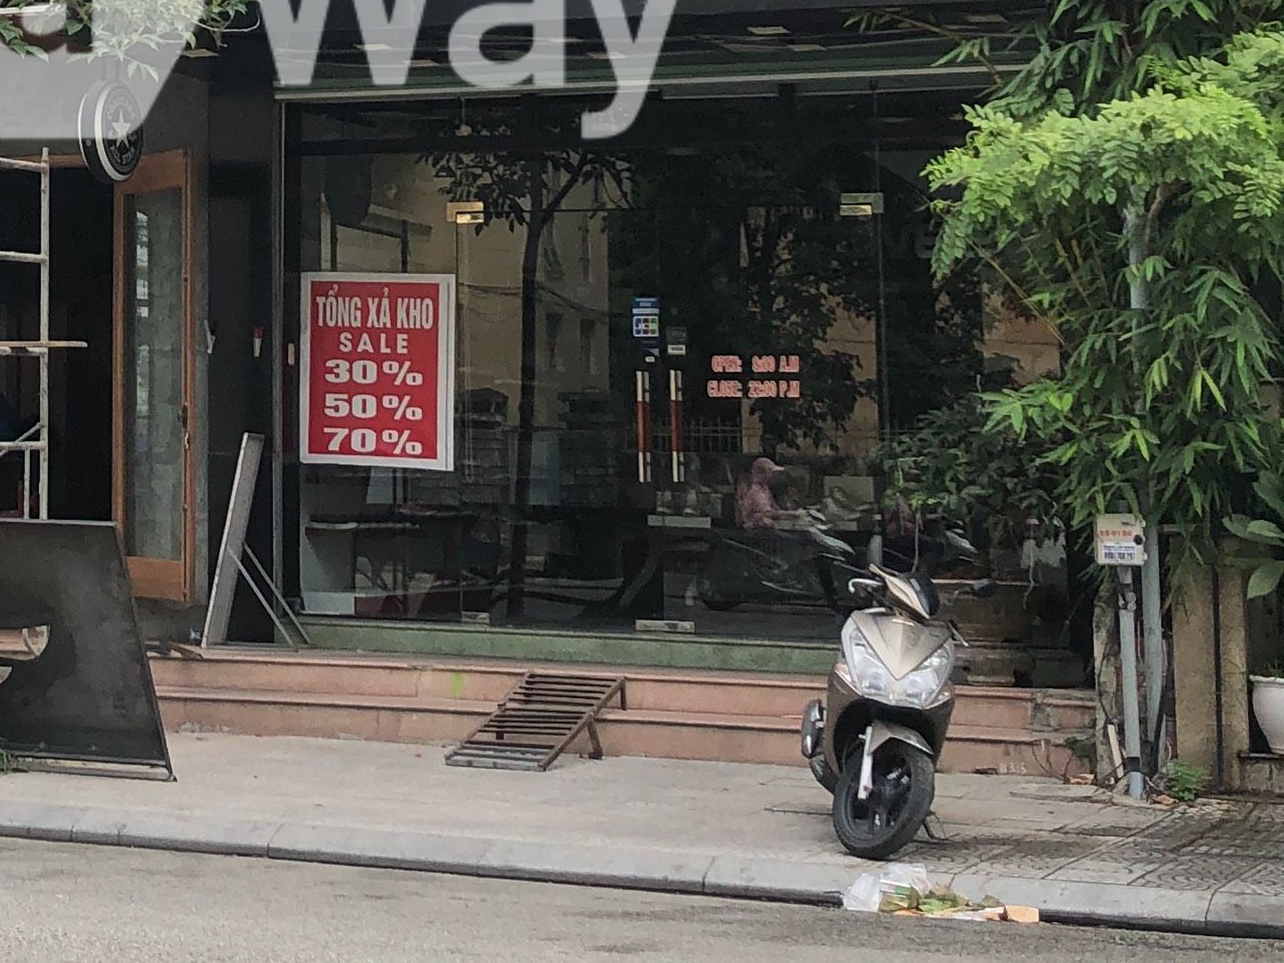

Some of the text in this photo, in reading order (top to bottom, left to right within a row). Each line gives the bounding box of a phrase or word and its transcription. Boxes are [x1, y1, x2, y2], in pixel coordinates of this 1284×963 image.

[316, 283, 434, 330] TỔNG XẢ KHO
[339, 331, 409, 354] SALE
